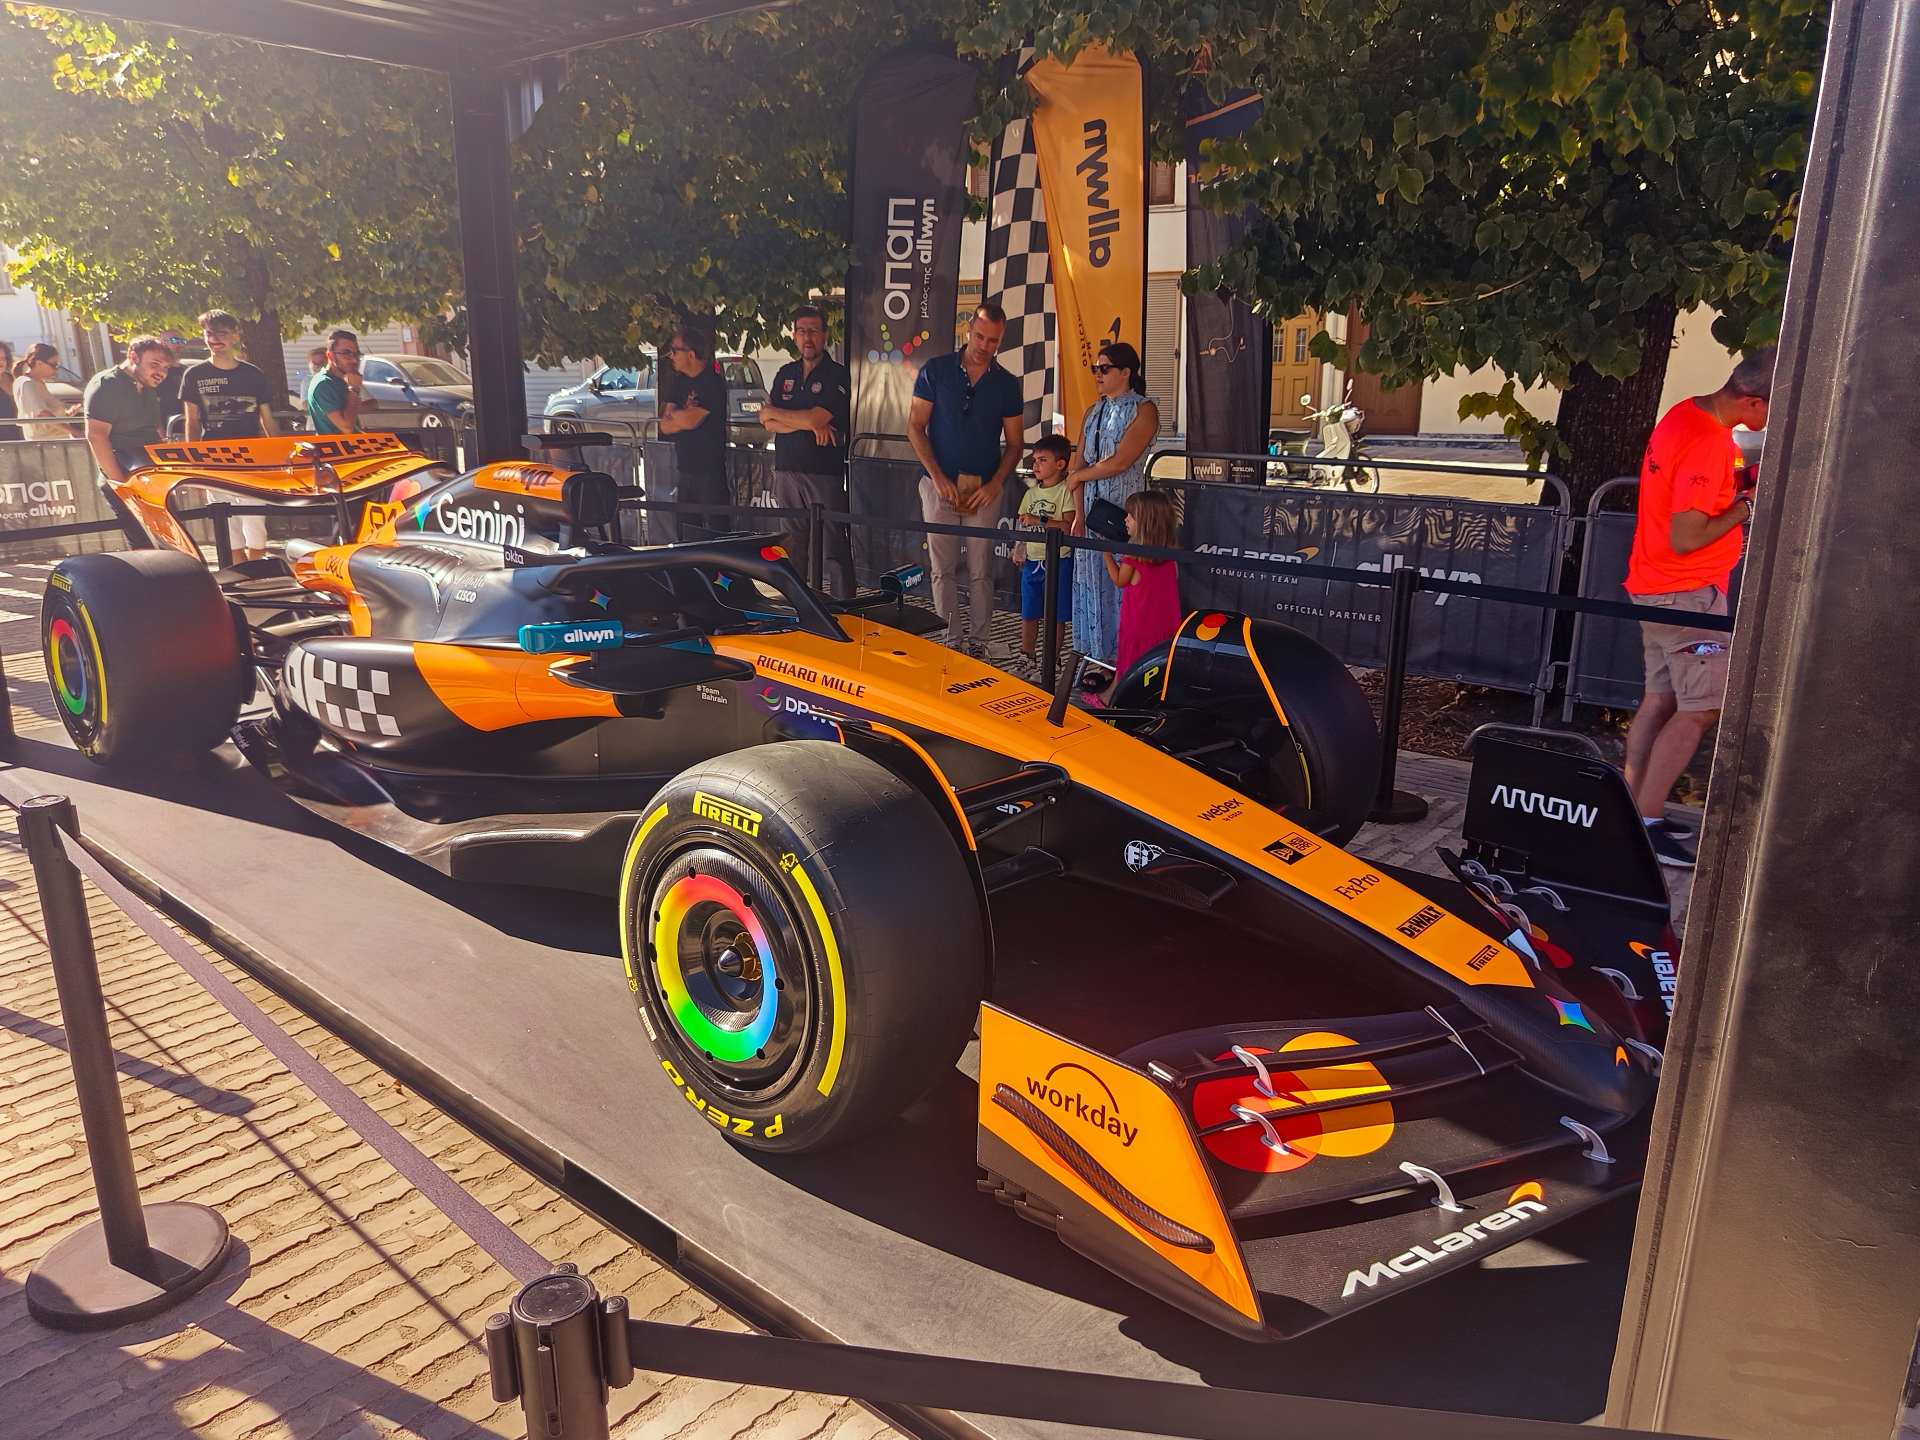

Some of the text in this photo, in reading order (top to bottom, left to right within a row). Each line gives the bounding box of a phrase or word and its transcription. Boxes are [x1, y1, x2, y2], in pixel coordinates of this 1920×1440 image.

[915, 198, 939, 264] allwyn
[197, 377, 229, 388] STOMPING
[198, 386, 221, 394] STREET
[493, 465, 554, 490] allwyn
[29, 503, 77, 518] allwyn
[437, 493, 525, 548] Gemini
[505, 550, 525, 565] okta
[52, 573, 72, 593] PIRELLI
[1210, 567, 1256, 580] FORMULA
[1271, 575, 1299, 585] TEAM
[1276, 603, 1382, 622] OFFICIAL PARTNER
[563, 629, 615, 643] allwyn
[757, 655, 866, 698] RICHARD MILLE
[946, 677, 1000, 694] allwyn
[702, 693, 728, 705] Bahrain
[785, 696, 810, 716] DP
[988, 695, 1037, 712] Hilton
[692, 790, 763, 838] PIRELLI
[1197, 798, 1245, 822] webex
[1490, 785, 1599, 828] ARROW
[1333, 873, 1380, 901] FxPro
[1466, 944, 1500, 972] PIRELLI
[661, 1060, 784, 1139] P ZERO
[1026, 1076, 1139, 1148] workday
[1341, 1200, 1547, 1298] McLaren
